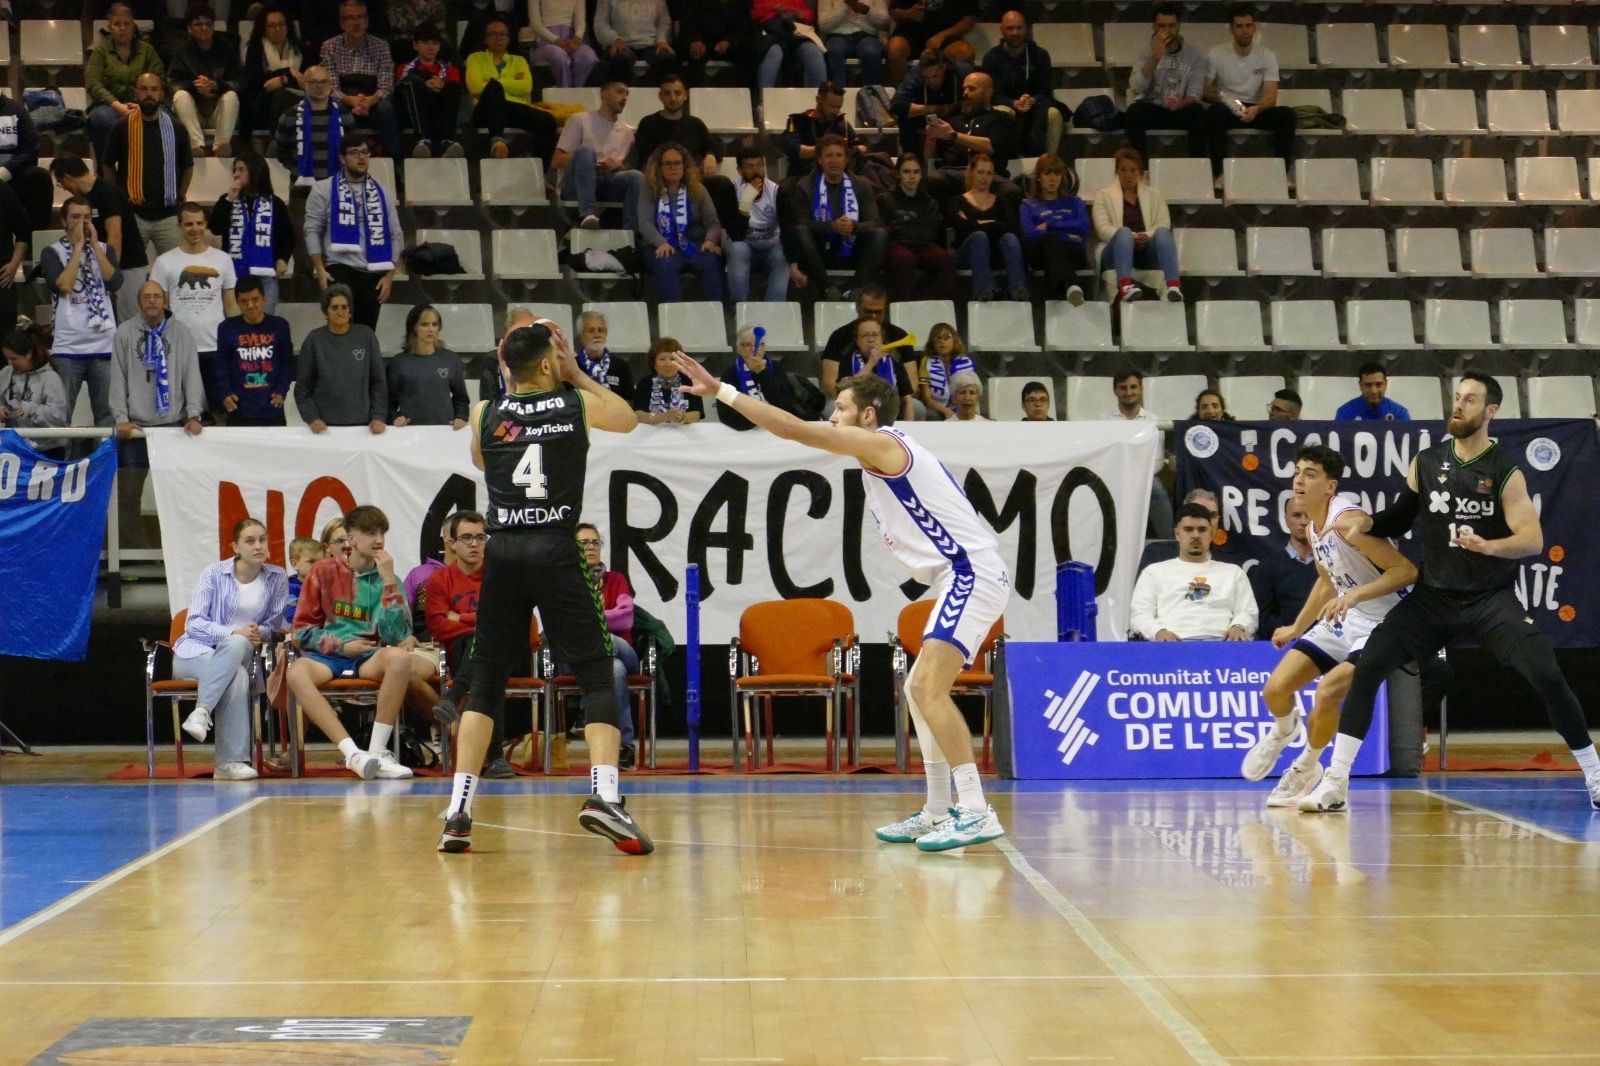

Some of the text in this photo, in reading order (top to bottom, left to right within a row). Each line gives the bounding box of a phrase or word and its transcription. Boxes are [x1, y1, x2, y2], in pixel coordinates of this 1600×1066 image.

[525, 423, 574, 436] XoyTicket
[511, 443, 548, 500] 4
[508, 505, 572, 525] MEDAC
[1455, 497, 1495, 516] Xoy
[609, 466, 1117, 602] RACIMO
[1107, 668, 1212, 686] Comunitat
[1107, 690, 1317, 720] COMUNIAT
[1125, 723, 1174, 750] DE
